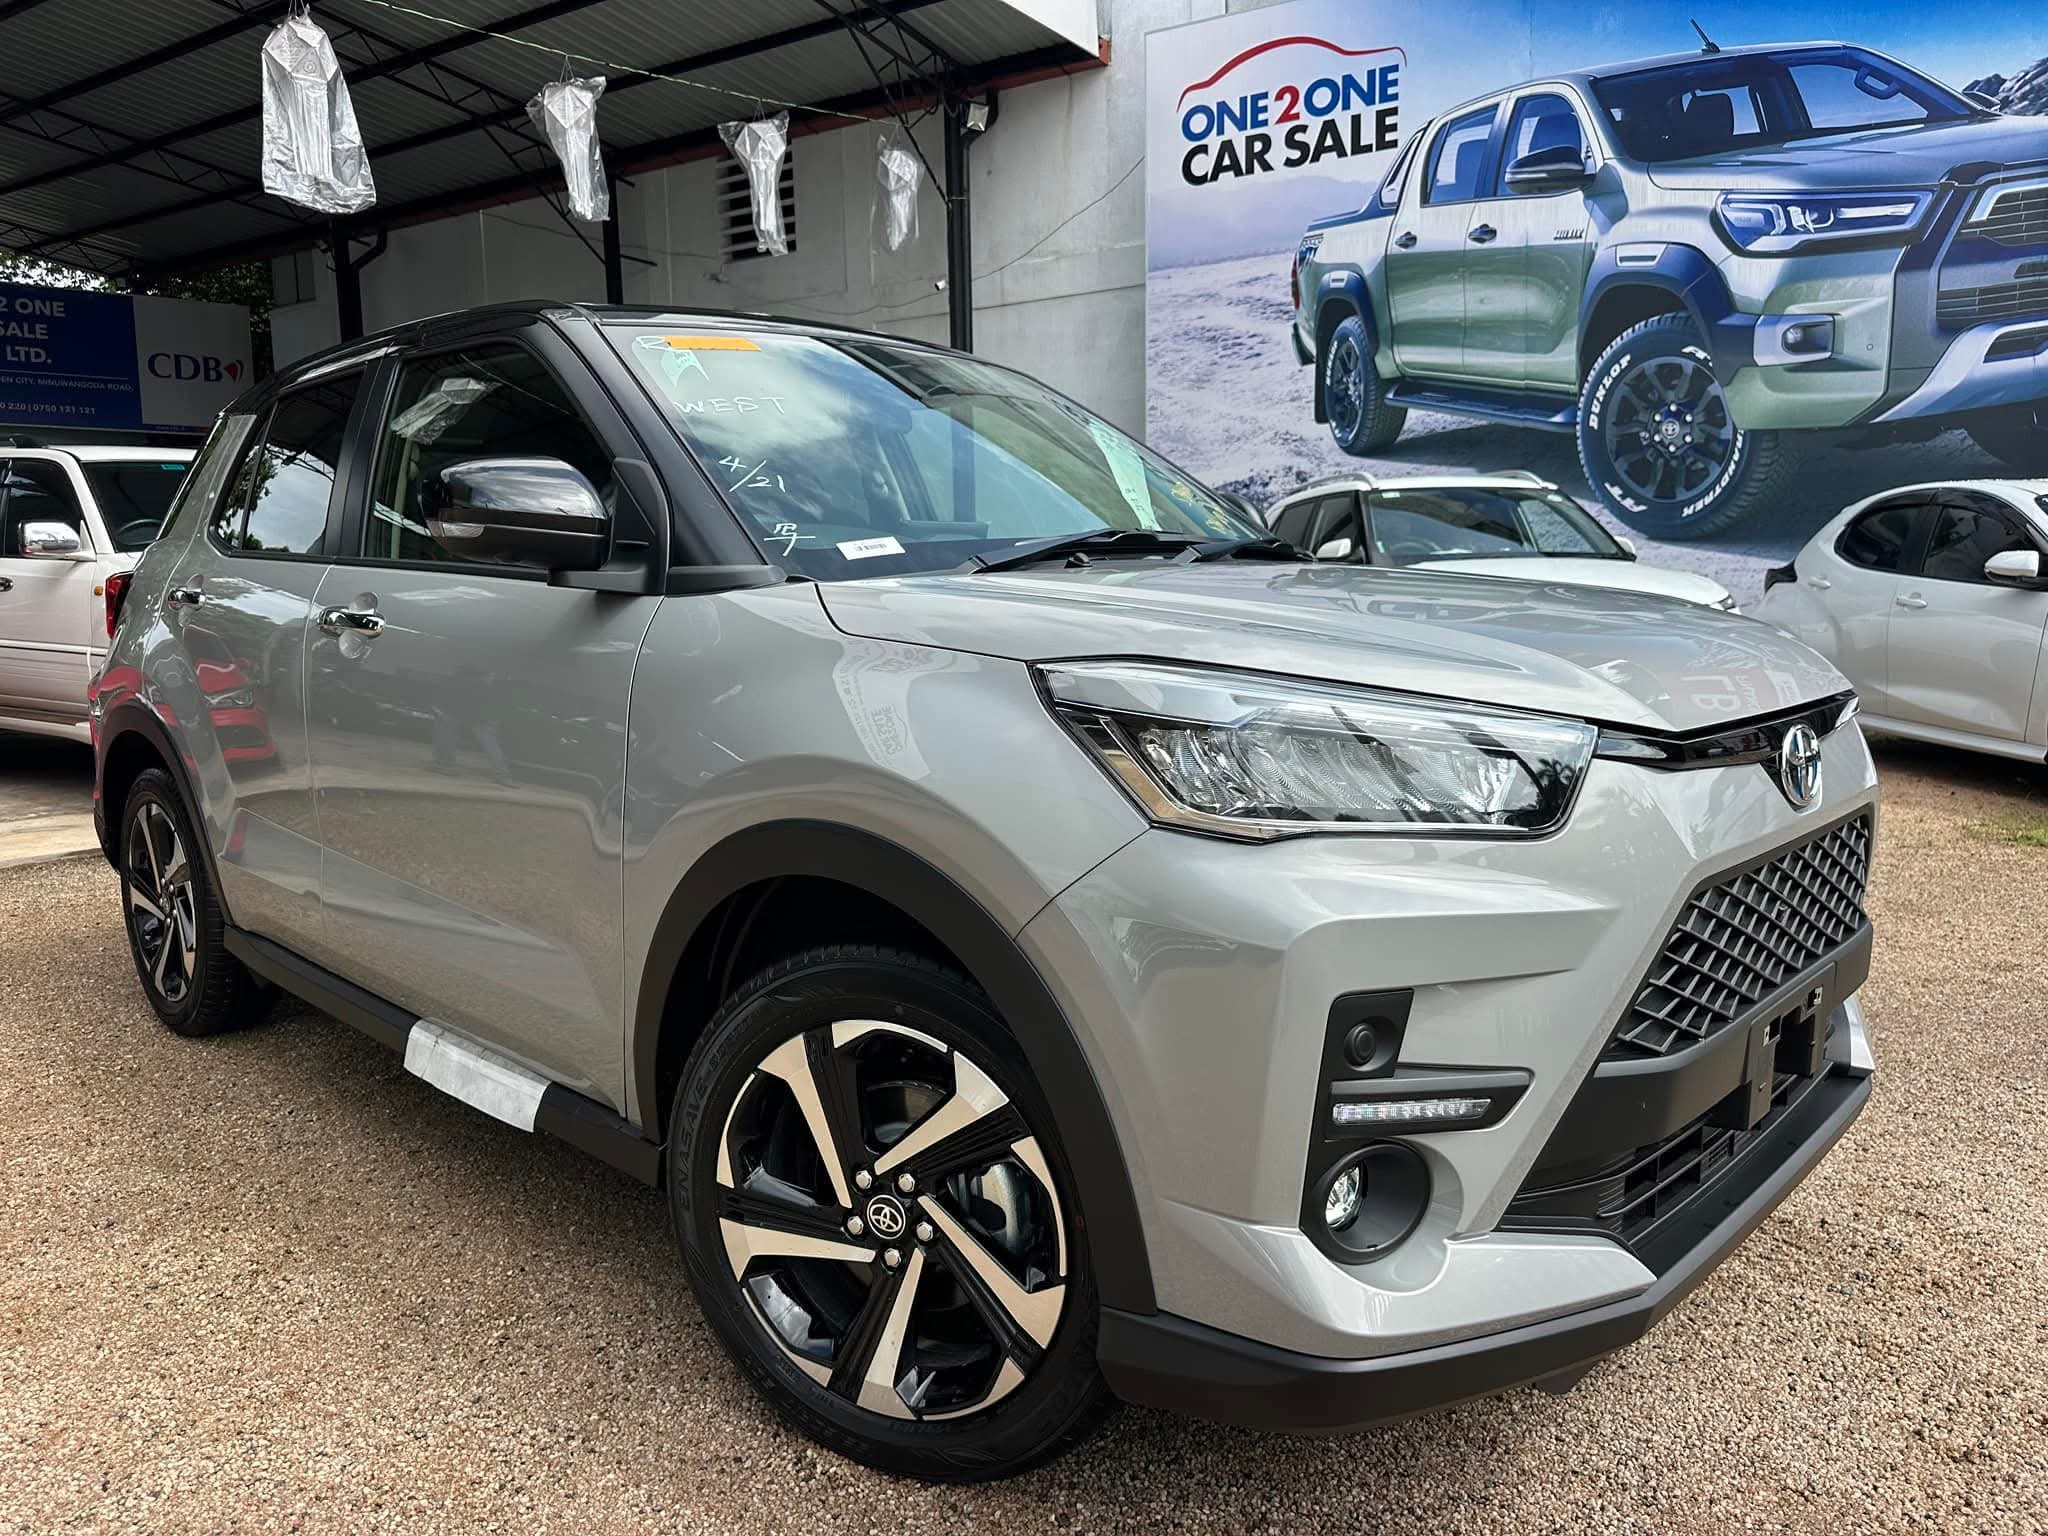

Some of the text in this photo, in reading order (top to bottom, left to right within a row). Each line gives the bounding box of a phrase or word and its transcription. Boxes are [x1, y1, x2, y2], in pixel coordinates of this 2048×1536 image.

[1181, 106, 1399, 186] CAR SALE
[15, 297, 66, 317] ONE
[6, 345, 52, 364] LTD.
[147, 352, 223, 382] CDB
[673, 396, 785, 414] WEST
[1588, 353, 1632, 430] DUNLOP
[718, 455, 786, 493] 4/21
